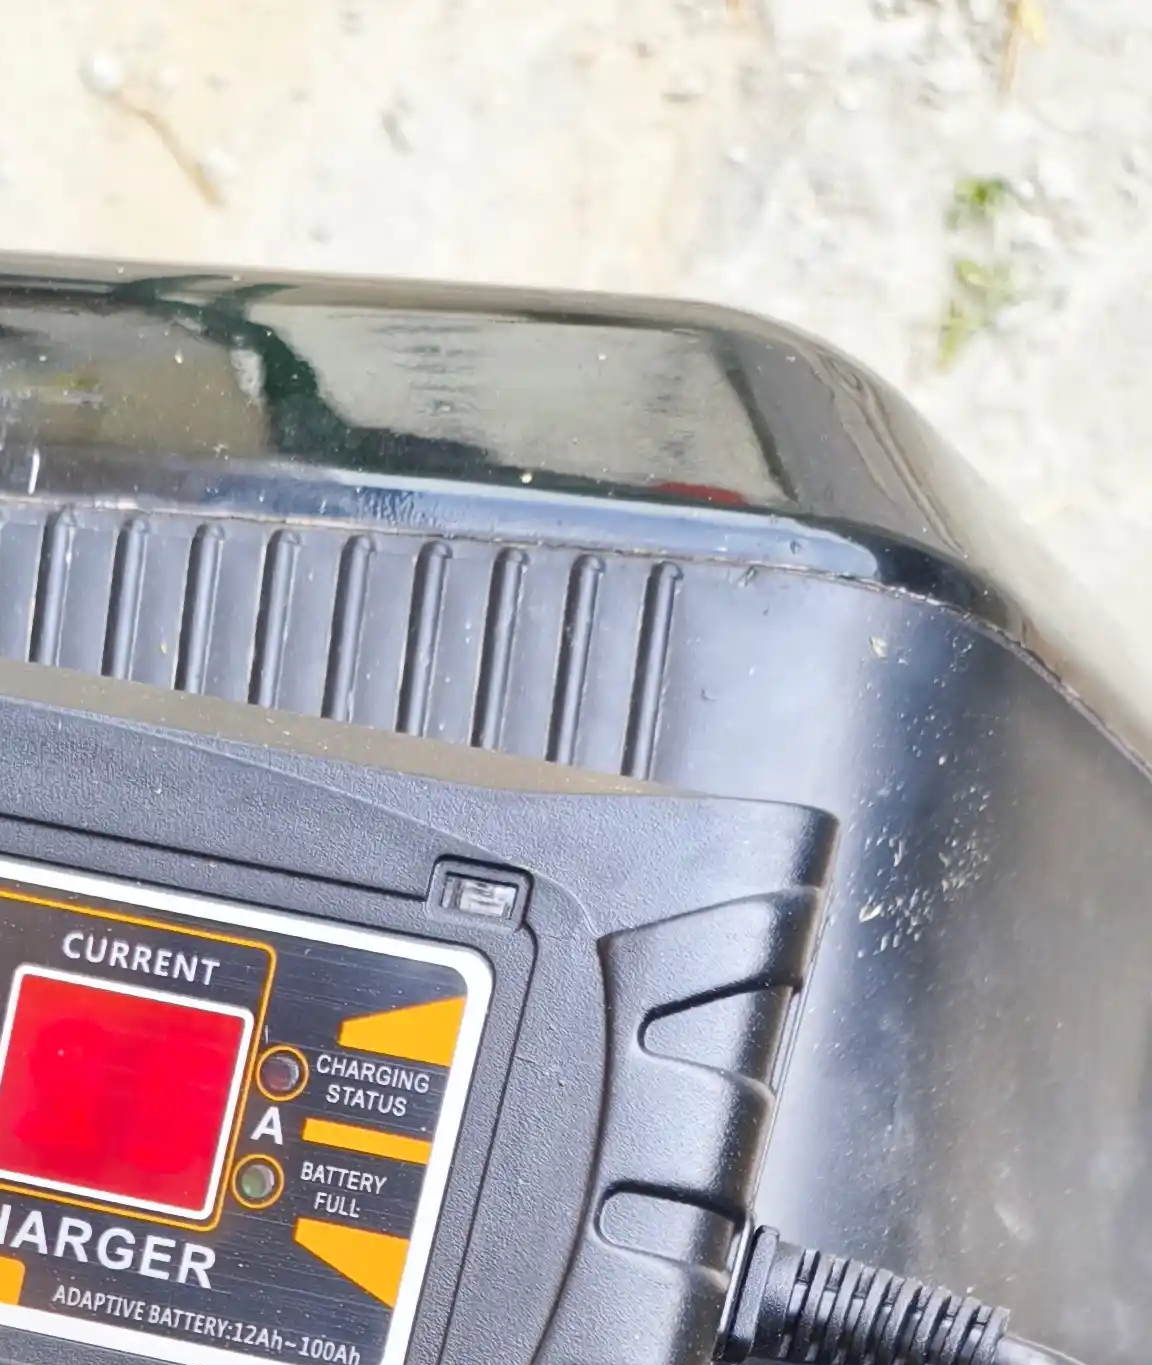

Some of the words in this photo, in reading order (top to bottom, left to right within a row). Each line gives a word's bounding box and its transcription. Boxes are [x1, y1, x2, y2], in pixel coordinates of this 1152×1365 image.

[61, 931, 221, 986] CURRENT
[316, 1053, 431, 1094] CHARGING
[326, 1083, 407, 1117] STATUS
[250, 1106, 284, 1146] A
[300, 1161, 388, 1195] BATTERY
[313, 1191, 361, 1219] FULL
[51, 1284, 146, 1322] ADAPTIVE
